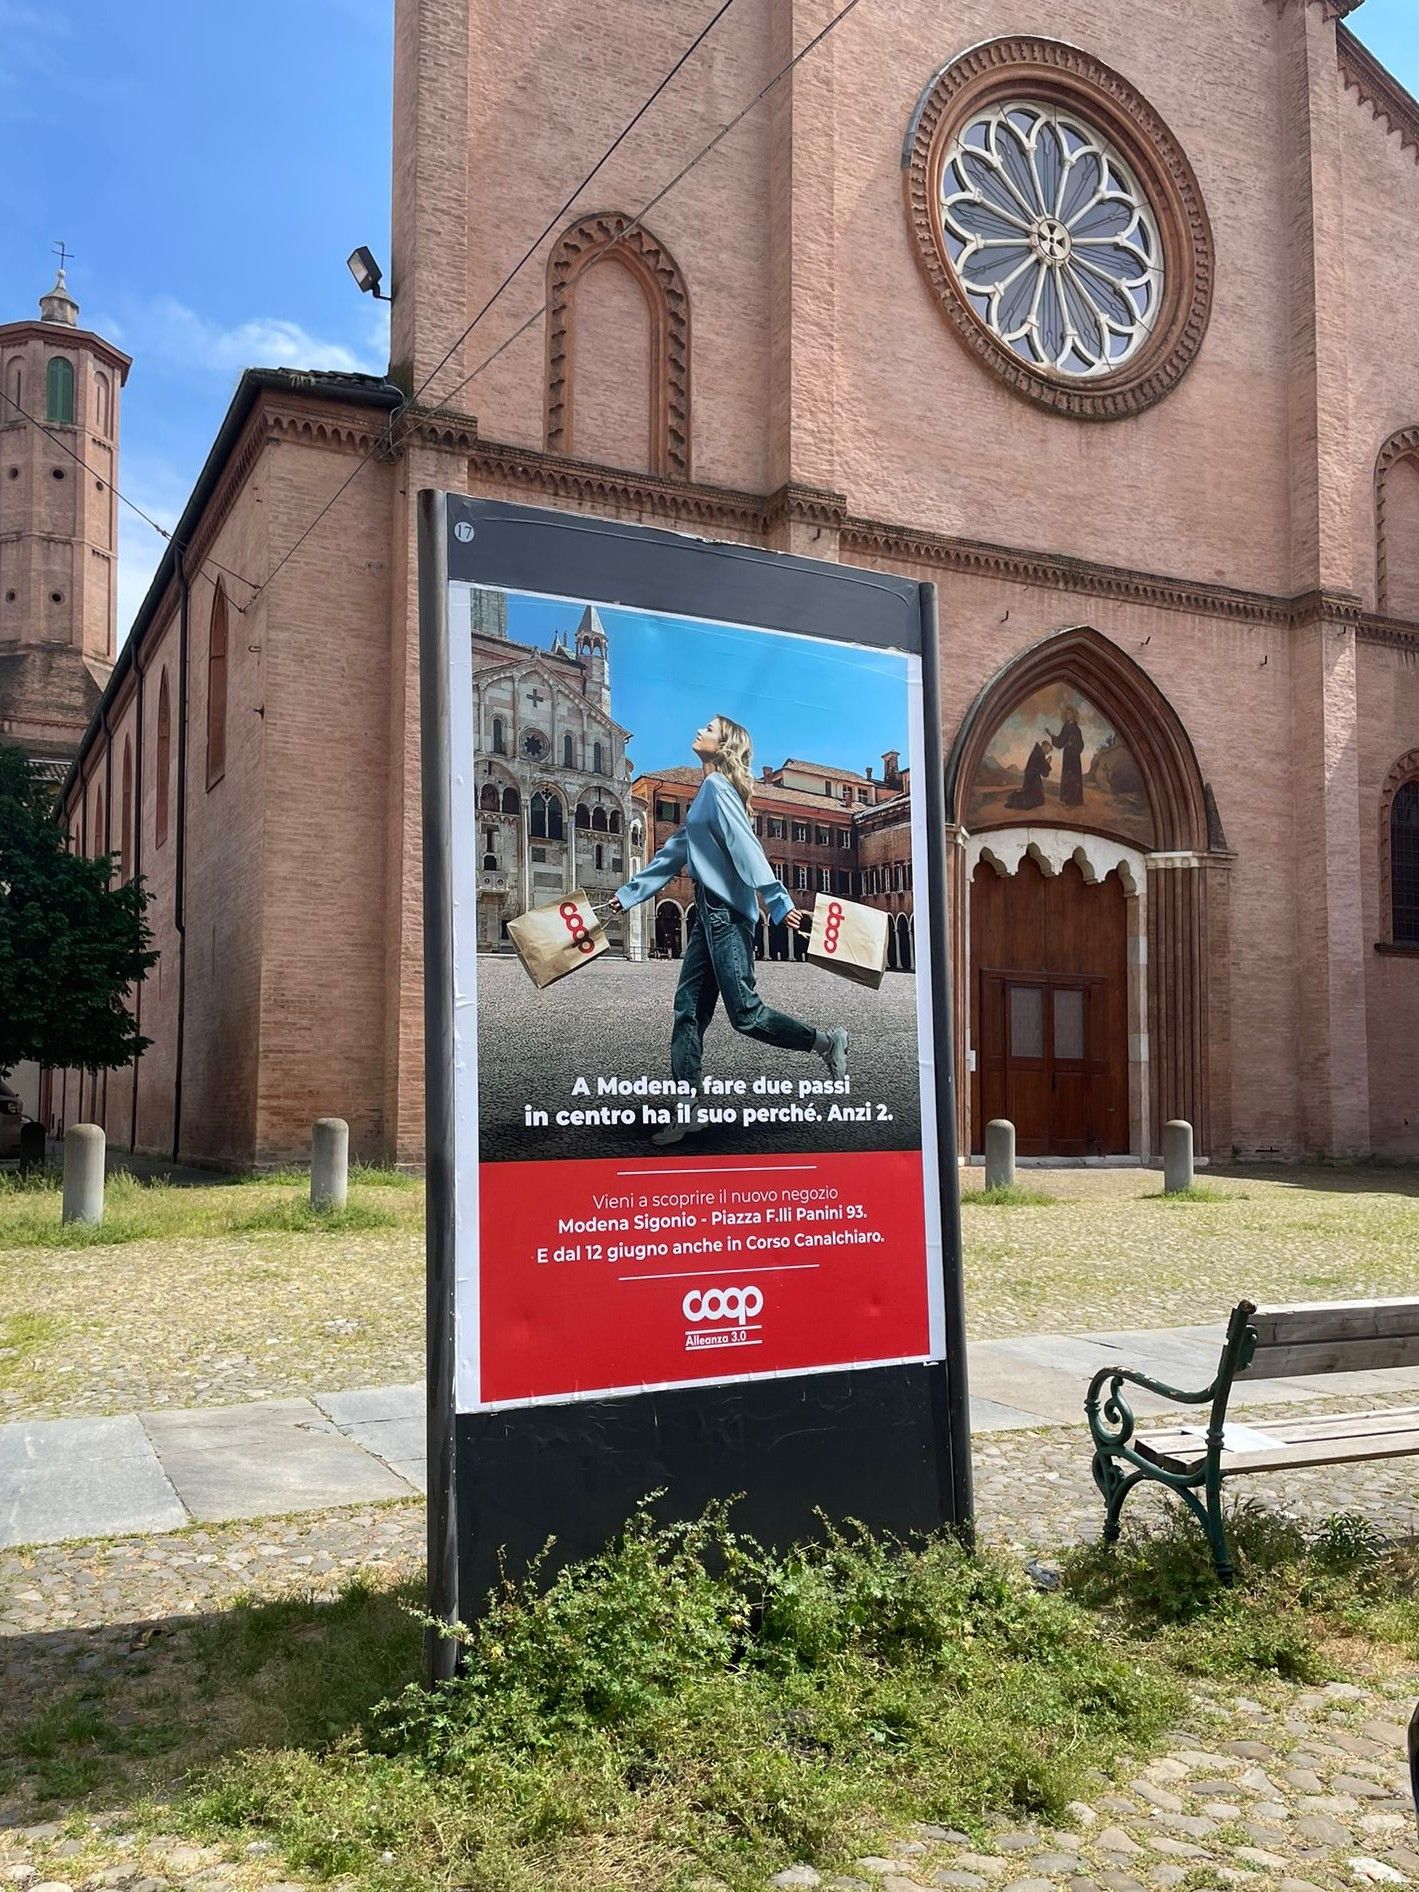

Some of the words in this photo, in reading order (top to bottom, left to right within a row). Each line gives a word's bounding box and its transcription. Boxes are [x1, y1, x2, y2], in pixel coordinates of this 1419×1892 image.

[457, 524, 472, 539] 17
[560, 901, 595, 954] coop
[823, 902, 845, 954] coop
[571, 1077, 591, 1096] A
[597, 1076, 697, 1098] Modena,
[703, 1075, 747, 1095] fare
[752, 1076, 793, 1094] due
[799, 1075, 850, 1098] passi
[524, 1104, 549, 1126] in
[555, 1107, 636, 1126] centro
[642, 1104, 671, 1124] ha
[677, 1103, 691, 1123] il
[697, 1107, 737, 1123] suo
[743, 1103, 823, 1127] perché.
[827, 1101, 872, 1122] Anzi
[876, 1103, 894, 1121] 2.
[592, 1193, 634, 1209] Vieni
[638, 1196, 648, 1207] a
[652, 1190, 715, 1208] scoprire
[719, 1189, 727, 1204] il
[731, 1190, 778, 1203] nuovo
[782, 1185, 839, 1204] negozio
[558, 1217, 629, 1234] Modena
[633, 1211, 697, 1232] Sigonio
[711, 1210, 761, 1226] Piazza
[766, 1206, 792, 1223] F.lli
[796, 1204, 843, 1222] Panini
[846, 1204, 868, 1219] 93.
[537, 1248, 549, 1263] E
[553, 1245, 581, 1262] dal
[585, 1244, 602, 1260] 12
[607, 1242, 668, 1262] giugno
[672, 1237, 723, 1255] anche
[727, 1236, 742, 1251] in
[746, 1235, 791, 1250] Corso
[794, 1229, 885, 1247] Canalchiaro.
[682, 1285, 764, 1326] coop
[685, 1334, 729, 1347] Alleanza
[731, 1330, 747, 1343] 3.0
